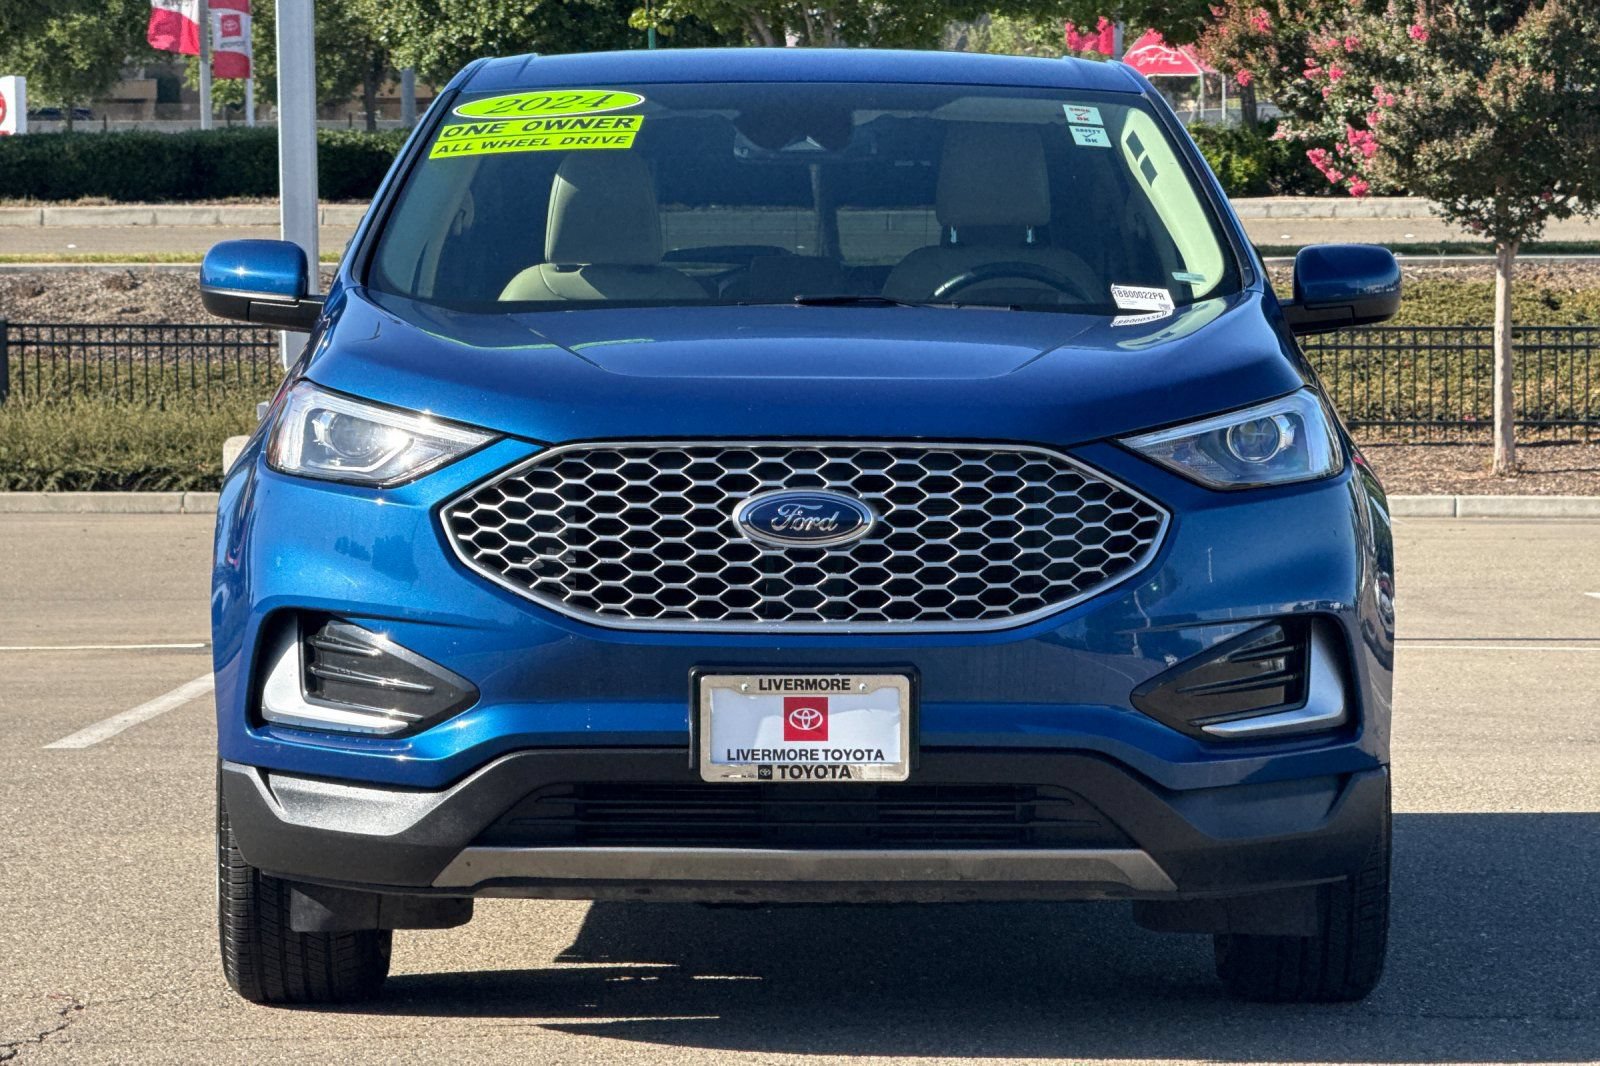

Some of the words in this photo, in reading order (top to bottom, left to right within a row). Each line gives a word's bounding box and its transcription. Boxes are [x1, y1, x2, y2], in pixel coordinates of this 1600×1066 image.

[483, 94, 615, 115] 2024
[442, 122, 509, 138] ONE
[522, 117, 635, 132] OWNER
[435, 143, 473, 154] ALL
[481, 138, 550, 149] WHEEL
[559, 135, 630, 146] DRIVE
[770, 503, 840, 532] Ford
[758, 678, 851, 691] LIVERMORE
[727, 749, 819, 761] LIVERMORE
[822, 748, 885, 761] TOYOTA
[777, 764, 852, 779] TOYOTA
